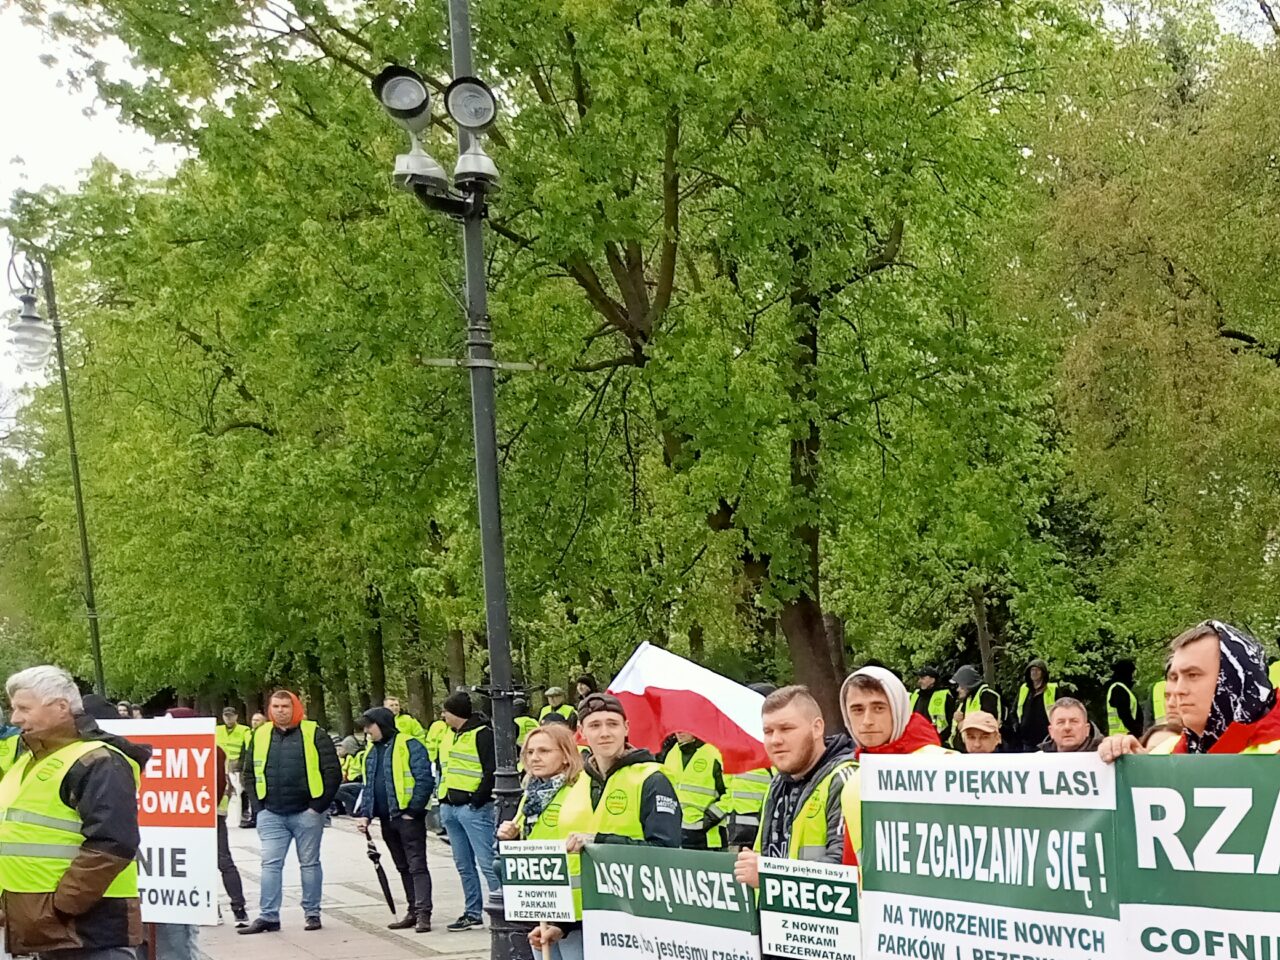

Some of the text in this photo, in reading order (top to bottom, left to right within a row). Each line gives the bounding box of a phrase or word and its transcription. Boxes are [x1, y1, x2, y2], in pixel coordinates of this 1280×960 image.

[145, 748, 211, 779] EMY
[878, 769, 937, 793] MAMY
[945, 770, 1030, 799] PIĘKNY
[136, 847, 187, 878] NIE
[505, 857, 565, 881] PRECZ
[763, 862, 790, 873] Mamy
[792, 865, 823, 877] piękne
[825, 868, 844, 879] lasy
[875, 820, 911, 874] NIE
[916, 822, 1040, 887] ZGADZAMY
[1046, 828, 1093, 909] SIĘ
[138, 886, 200, 908] TOWAĆ
[517, 890, 558, 898] Z NOWYMI
[594, 861, 635, 900] LASY
[639, 864, 673, 914] SĄ
[669, 867, 740, 912] NASZE
[764, 877, 852, 916] PRECZ
[514, 910, 571, 919] REZERWATAMI
[521, 901, 557, 909] PARKAMI
[781, 919, 840, 936] Z NOWYMI
[883, 904, 1106, 953] NA TWORZENIE NOWYCH
[785, 932, 837, 948] PARKAMI
